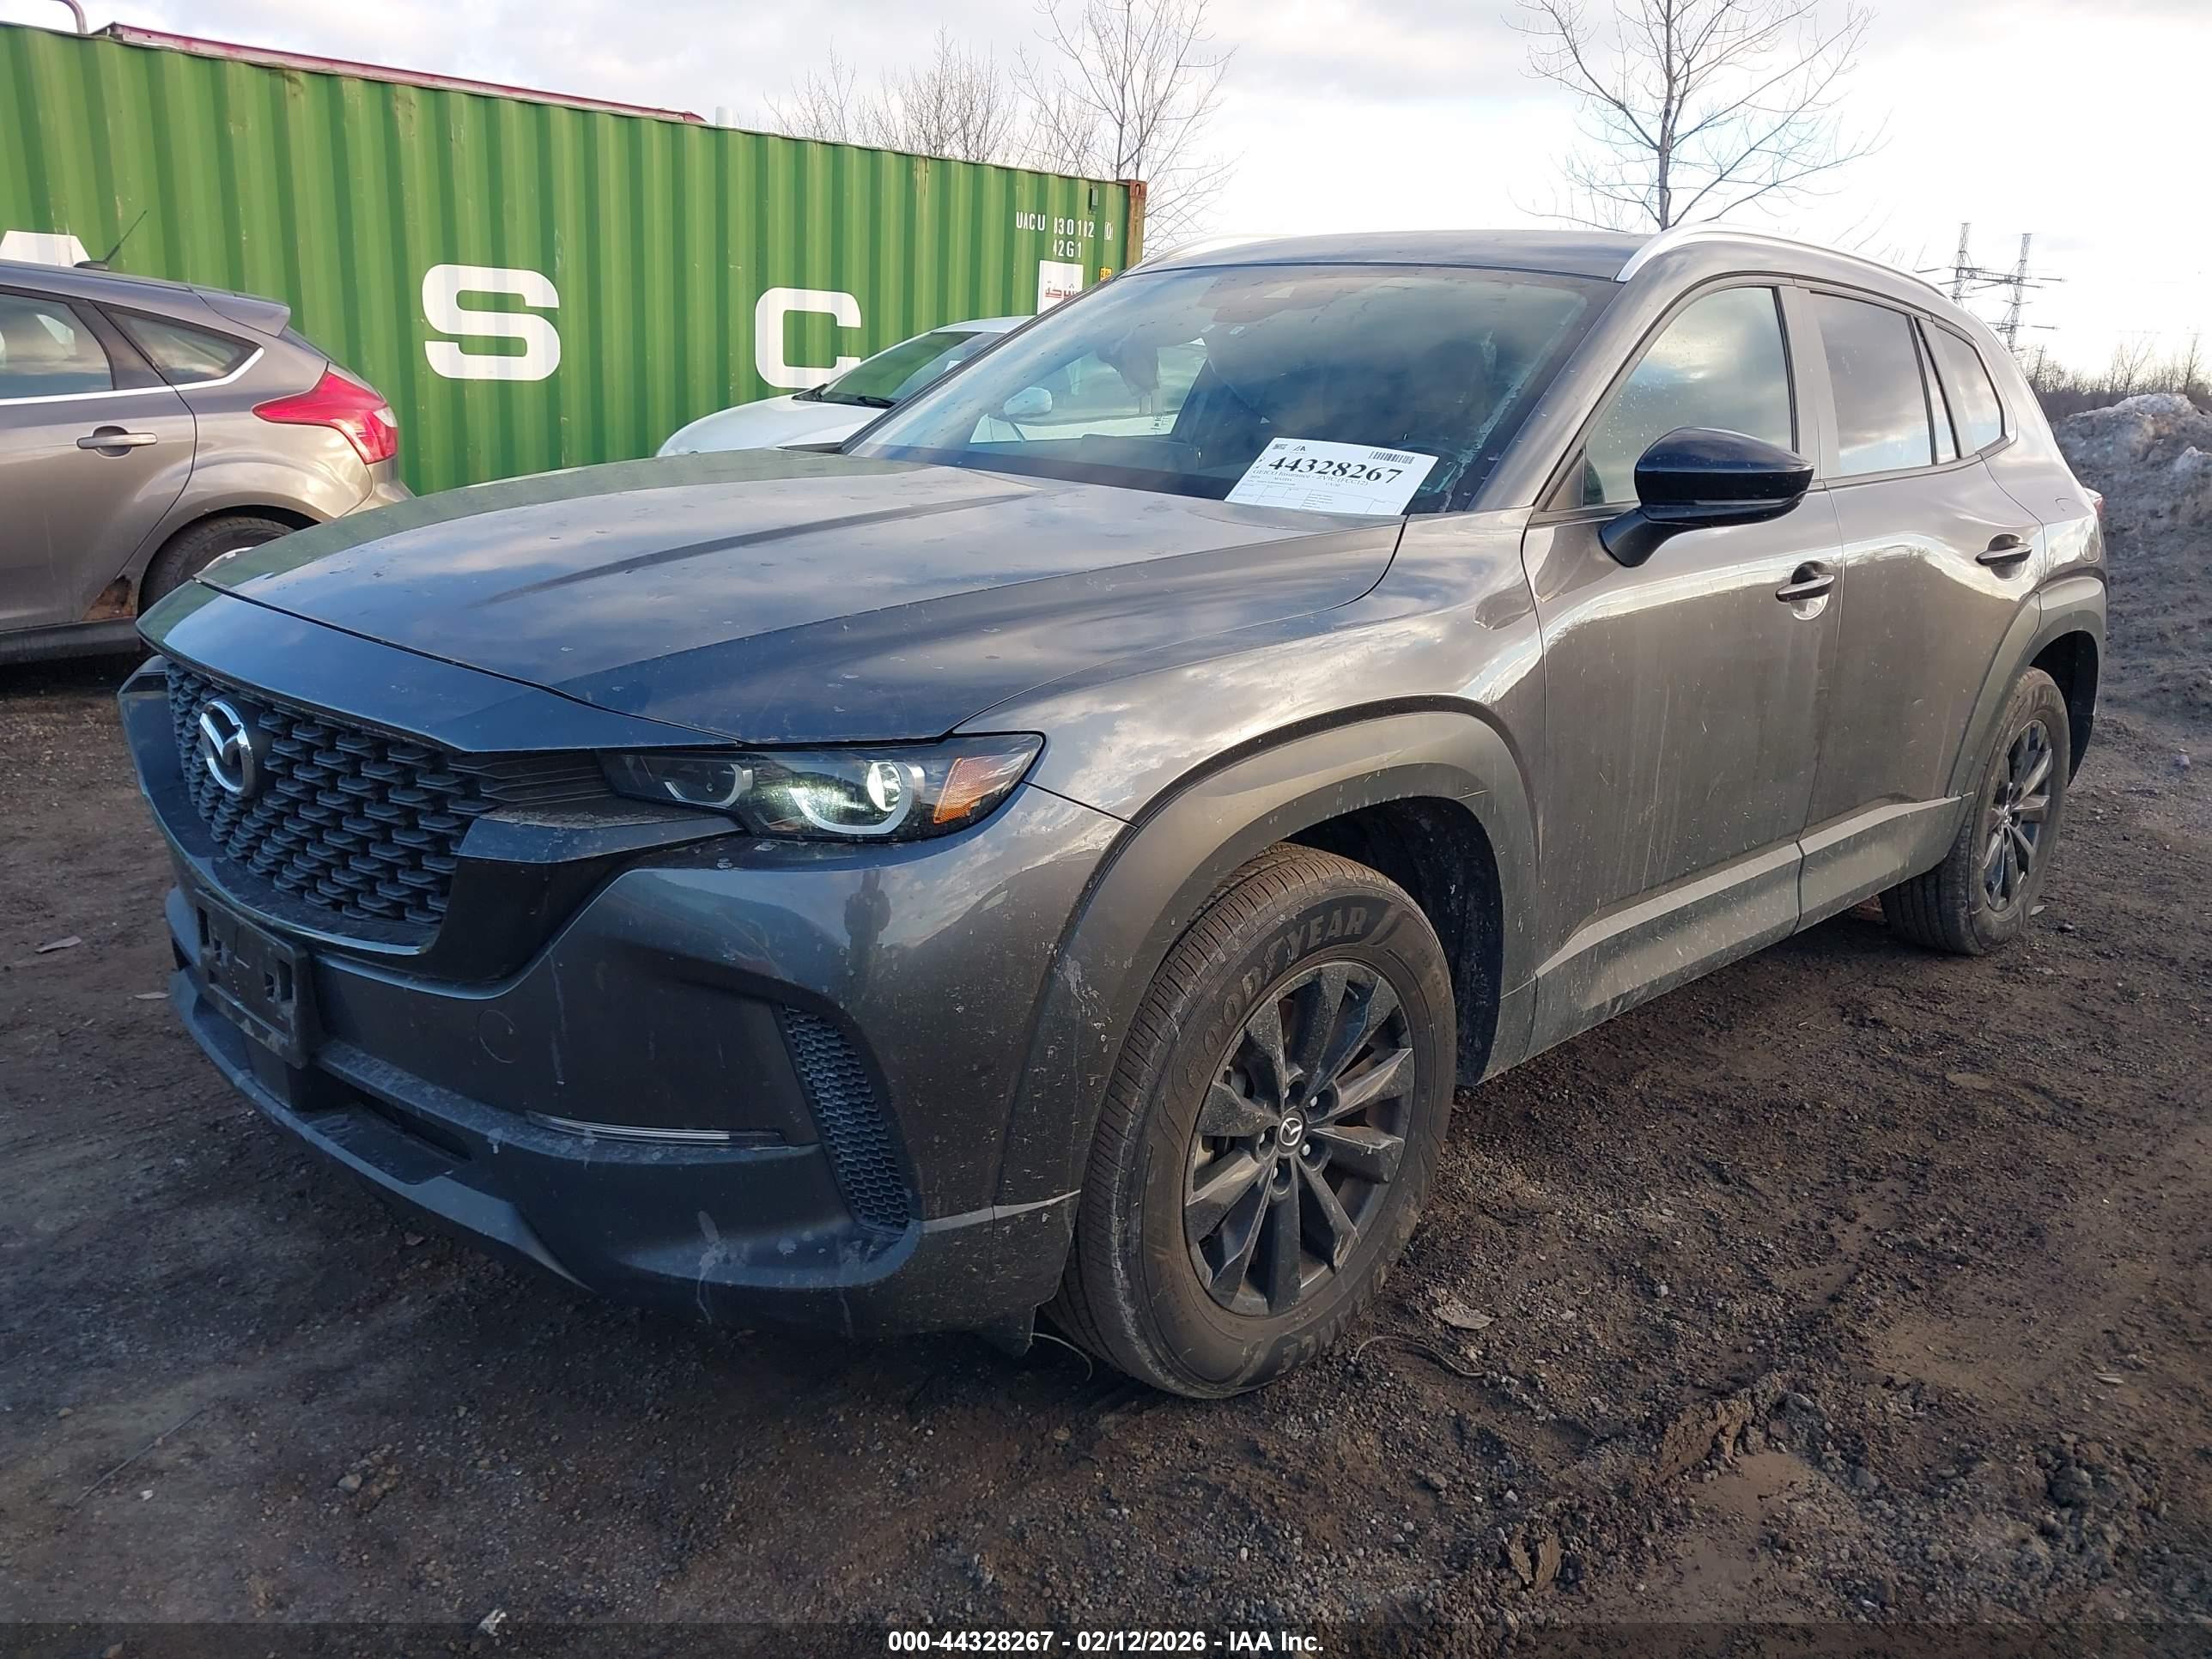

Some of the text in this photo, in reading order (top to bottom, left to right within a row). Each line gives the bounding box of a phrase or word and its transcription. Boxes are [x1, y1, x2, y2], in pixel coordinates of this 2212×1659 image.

[1016, 211, 1046, 231] UACU
[1053, 216, 1095, 238] 830182
[422, 264, 861, 389] S C
[1268, 456, 1404, 483] 44328267
